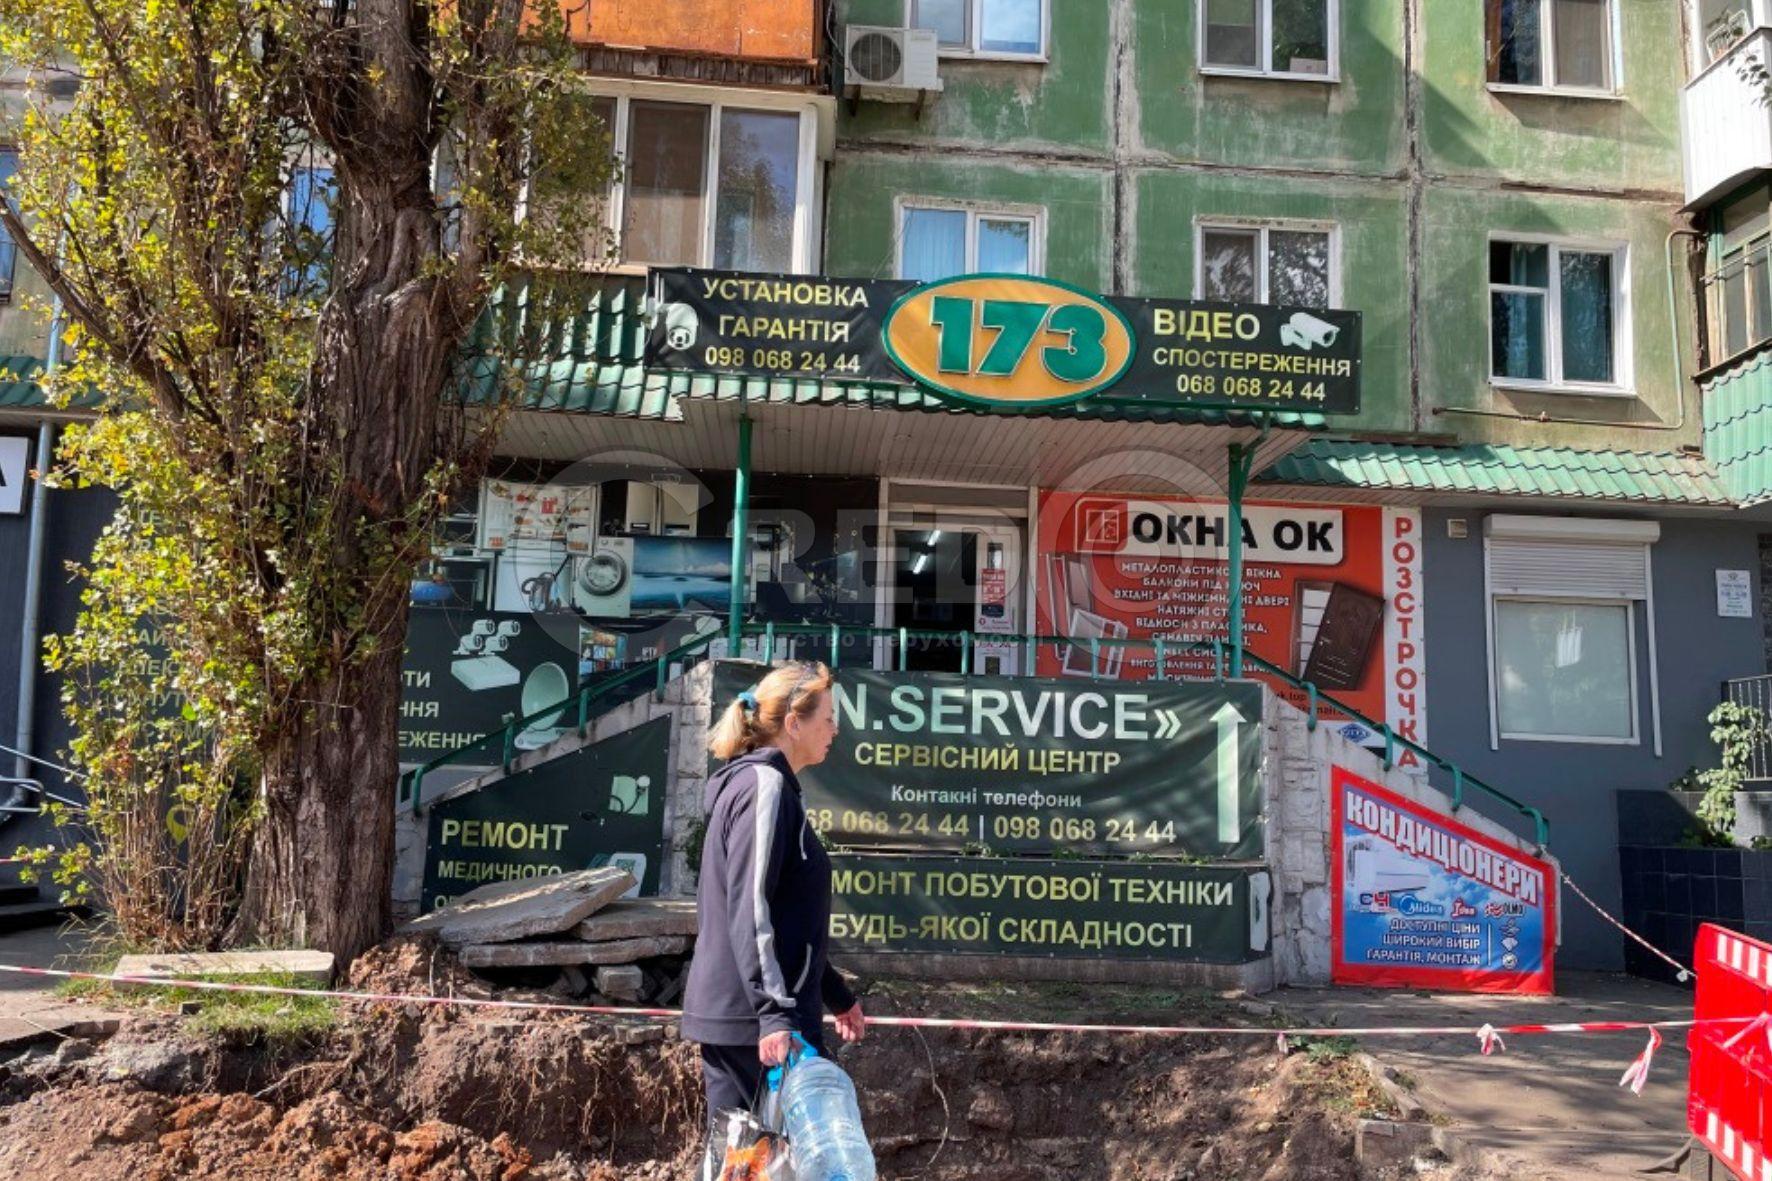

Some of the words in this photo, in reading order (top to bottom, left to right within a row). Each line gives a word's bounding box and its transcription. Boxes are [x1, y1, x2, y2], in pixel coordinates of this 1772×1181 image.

[703, 278, 868, 307] УСТАНОВКА
[719, 316, 849, 342] ГАРАНТІЯ
[930, 295, 1107, 382] 173
[1153, 308, 1260, 342] ВІДЕО
[705, 347, 744, 366] 098
[753, 350, 792, 370] 068
[800, 352, 827, 371] 24
[833, 354, 861, 373] 44
[1153, 347, 1351, 377] СПОСТЕРЕЖЕННЯ
[1177, 375, 1215, 394] 068
[1223, 377, 1260, 397] 068
[1269, 380, 1294, 399] 24
[1301, 382, 1326, 402] 44
[1132, 513, 1258, 549] ОКНА
[1273, 519, 1334, 552] ОК
[1121, 562, 1230, 577] МЕТАЛОПЛАСТИКО
[1392, 517, 1418, 768] РОЗСТРОЧКА
[399, 701, 440, 718] ННЯ
[831, 681, 1182, 741] N.SERVICE»
[855, 742, 1018, 771] СЕРВІСНИЙ
[1028, 750, 1122, 775] ЦЕНТР
[891, 784, 977, 805] Контакні
[983, 789, 1082, 810] телефони
[441, 819, 569, 851] РЕМОНТ
[804, 808, 833, 832] 68
[842, 811, 890, 834] 068
[899, 812, 930, 835] 24
[937, 814, 970, 837] 44
[993, 815, 1041, 840] 098
[1050, 817, 1097, 841] 068
[1105, 818, 1138, 842] 24
[1144, 820, 1177, 843] 44
[1347, 790, 1544, 906] КОНДИЦІОНЕРИ
[438, 860, 562, 882] МЕДИЧНОГО
[831, 869, 917, 896] МОНТ
[925, 870, 1101, 901] ПОБУТОВОЇ
[1109, 878, 1233, 906] ТЕХНІКИ
[828, 911, 991, 944] БУДЬ-ЯКОЇ
[998, 917, 1193, 949] СКЛАДНОСТІ
[1391, 918, 1447, 932] ДОСТУПНІ
[1452, 922, 1480, 934] ЦІНИ
[1367, 949, 1424, 964] ГАРАНТІЯ,
[1426, 952, 1480, 965] МОНТАЖ
[1383, 934, 1443, 947] ШИРОКИЙ
[1446, 936, 1480, 950] ВИБІР
